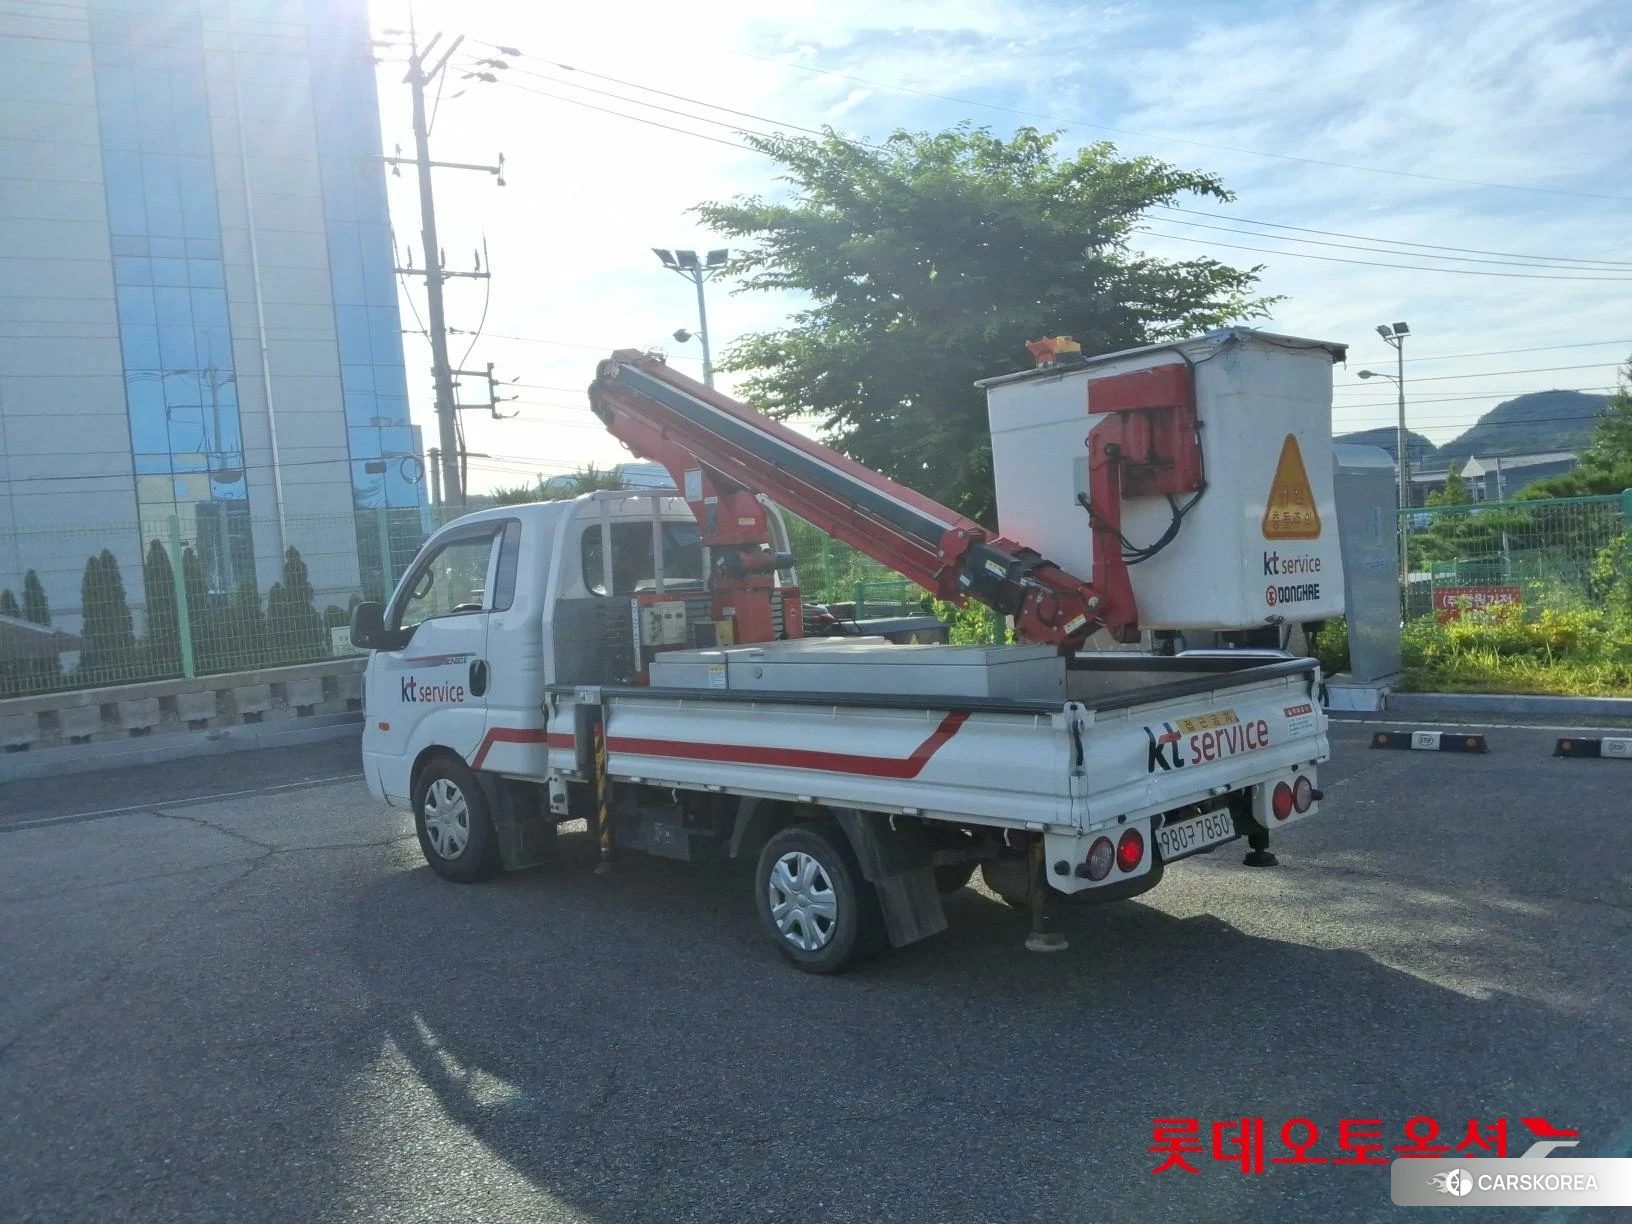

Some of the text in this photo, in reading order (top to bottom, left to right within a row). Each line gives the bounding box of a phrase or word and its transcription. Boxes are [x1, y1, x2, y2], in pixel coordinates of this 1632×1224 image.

[1264, 551, 1321, 575] kt service
[1278, 583, 1320, 603] DONGHAE
[401, 676, 465, 703] kt service
[1143, 719, 1269, 773] kt service
[1161, 813, 1230, 855] 980구 7850
